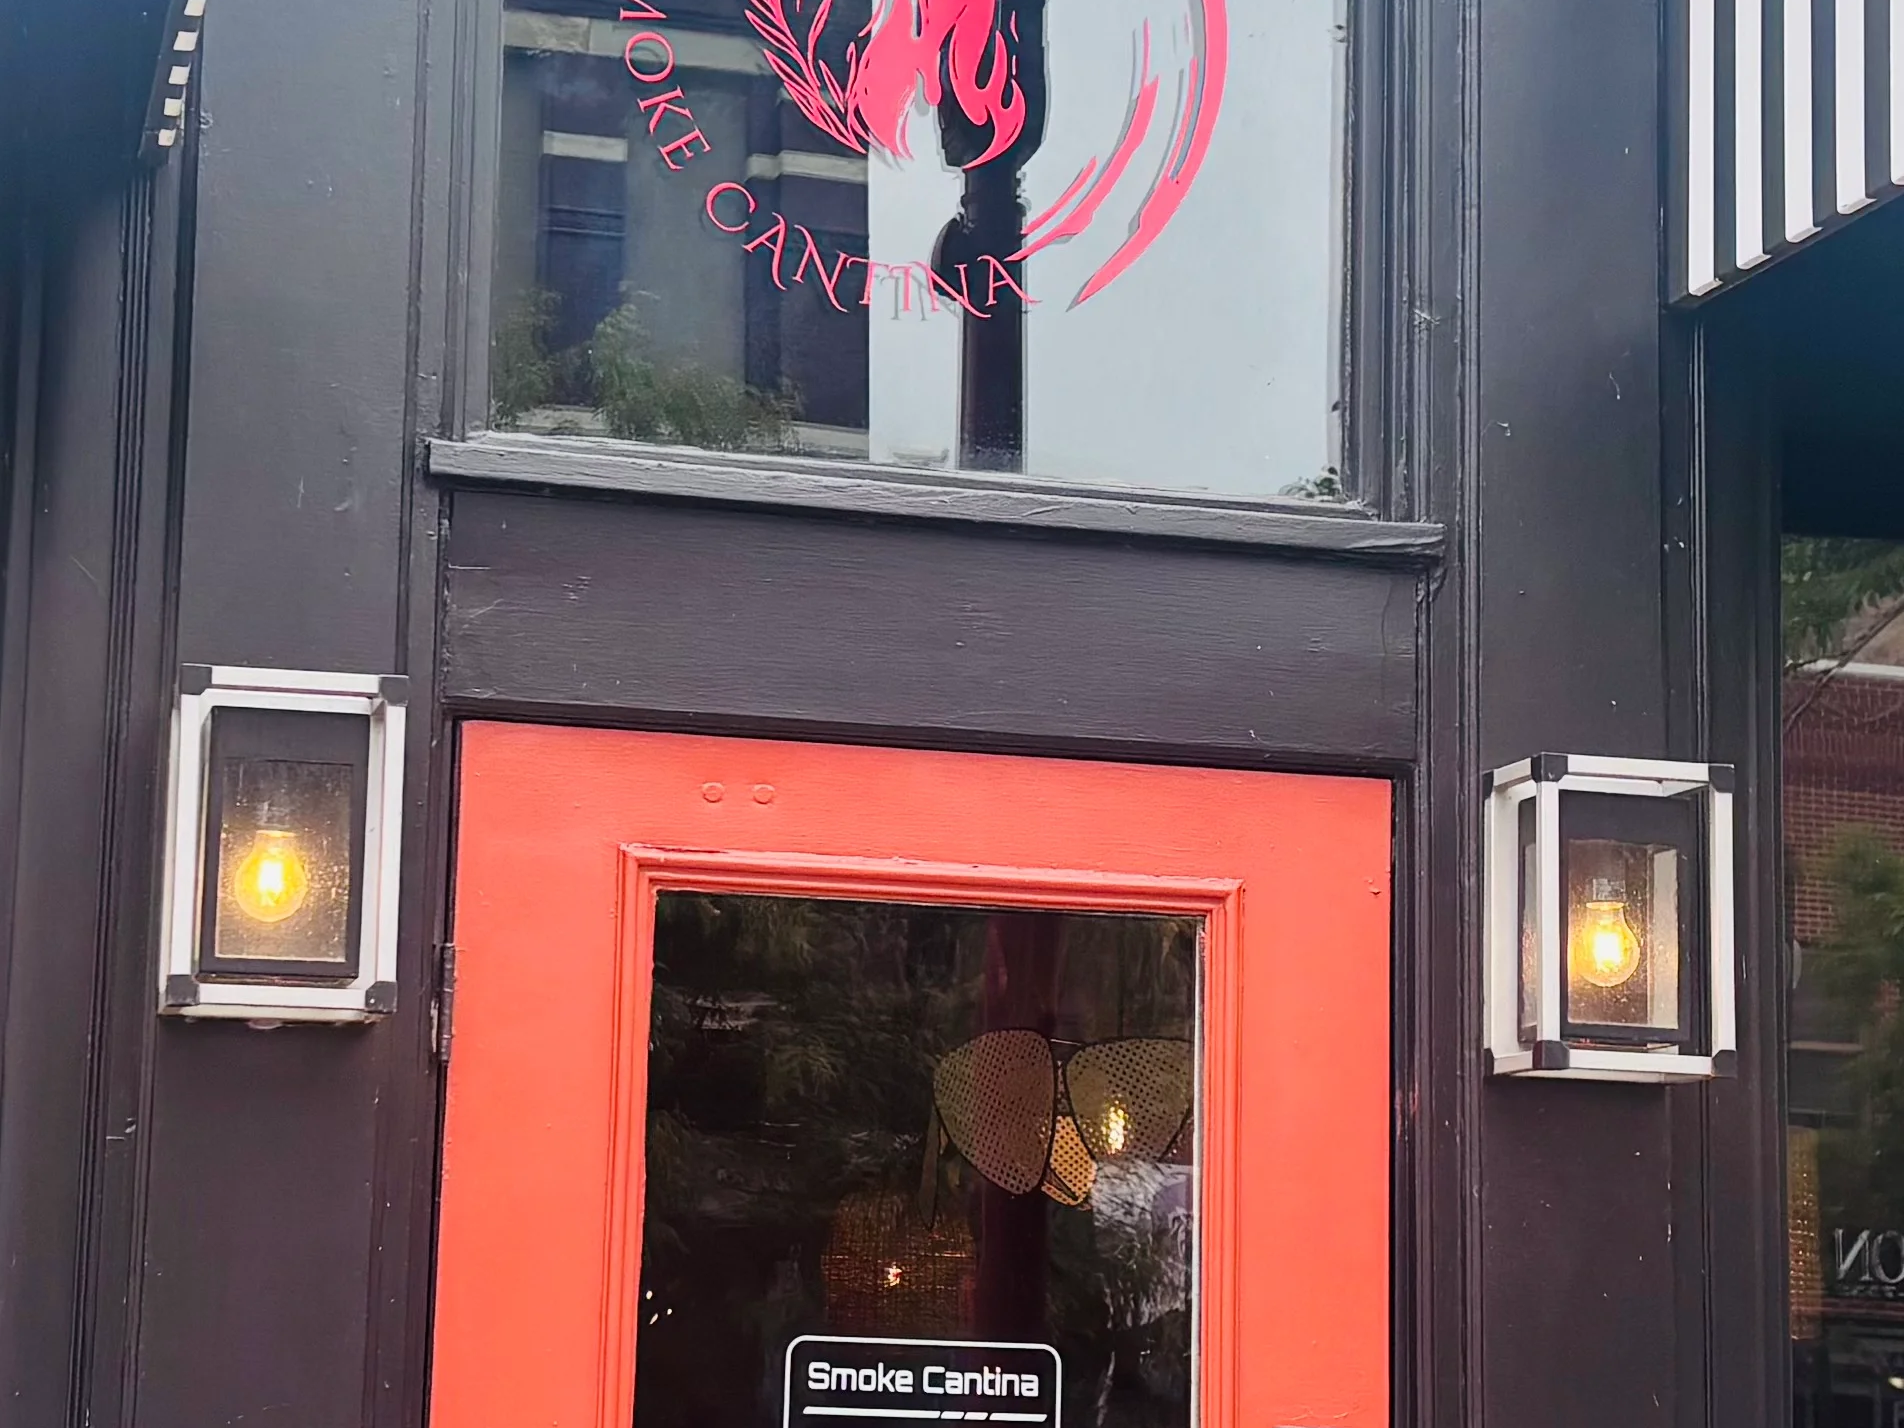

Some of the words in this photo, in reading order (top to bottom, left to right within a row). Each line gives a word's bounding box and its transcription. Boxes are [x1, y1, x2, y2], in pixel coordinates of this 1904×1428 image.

[705, 181, 1043, 319] CANTINA
[808, 1361, 914, 1395] Smoke
[922, 1365, 1040, 1398] Cantina
